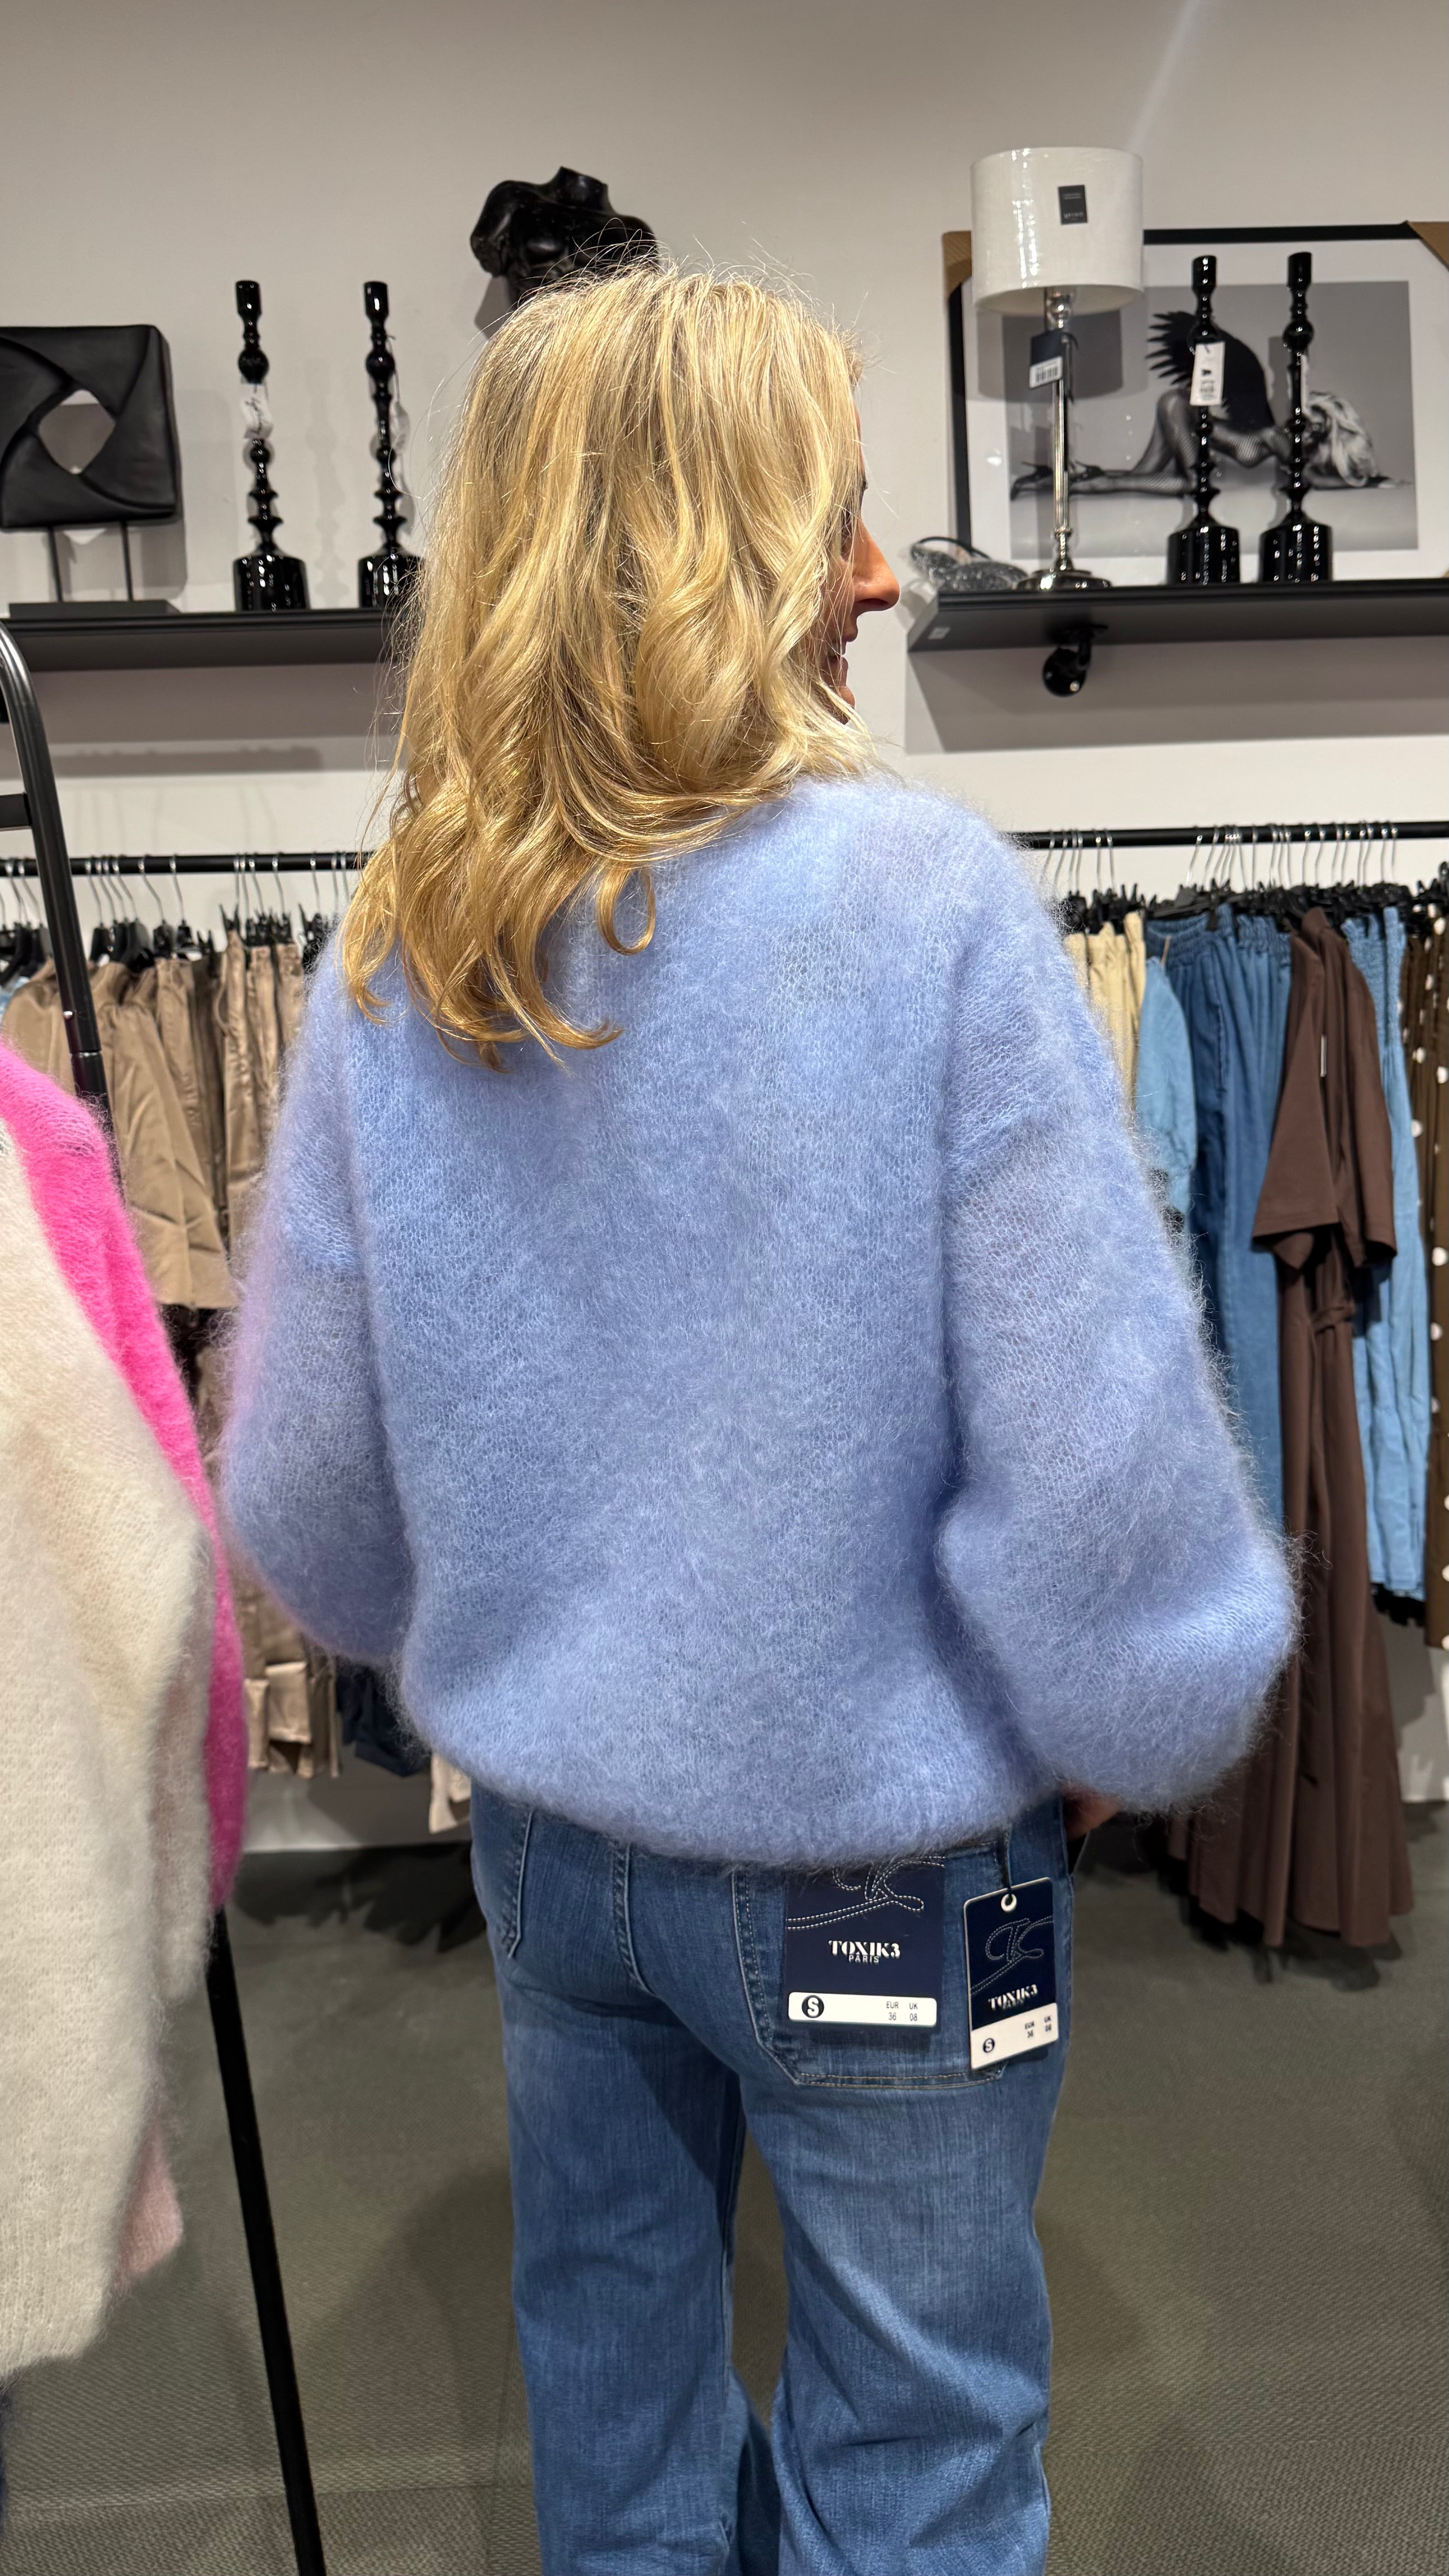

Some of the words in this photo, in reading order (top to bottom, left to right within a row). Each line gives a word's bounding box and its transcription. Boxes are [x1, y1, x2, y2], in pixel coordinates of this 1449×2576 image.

[828, 1940, 901, 1958] TOXIK3
[848, 1955, 880, 1964] PARIS
[988, 1984, 1038, 2010] TOXIK3
[806, 1996, 820, 2017] S
[886, 2001, 899, 2009] EUR
[888, 2012, 897, 2021] 36
[910, 2013, 918, 2022] 08
[984, 2038, 994, 2052] S
